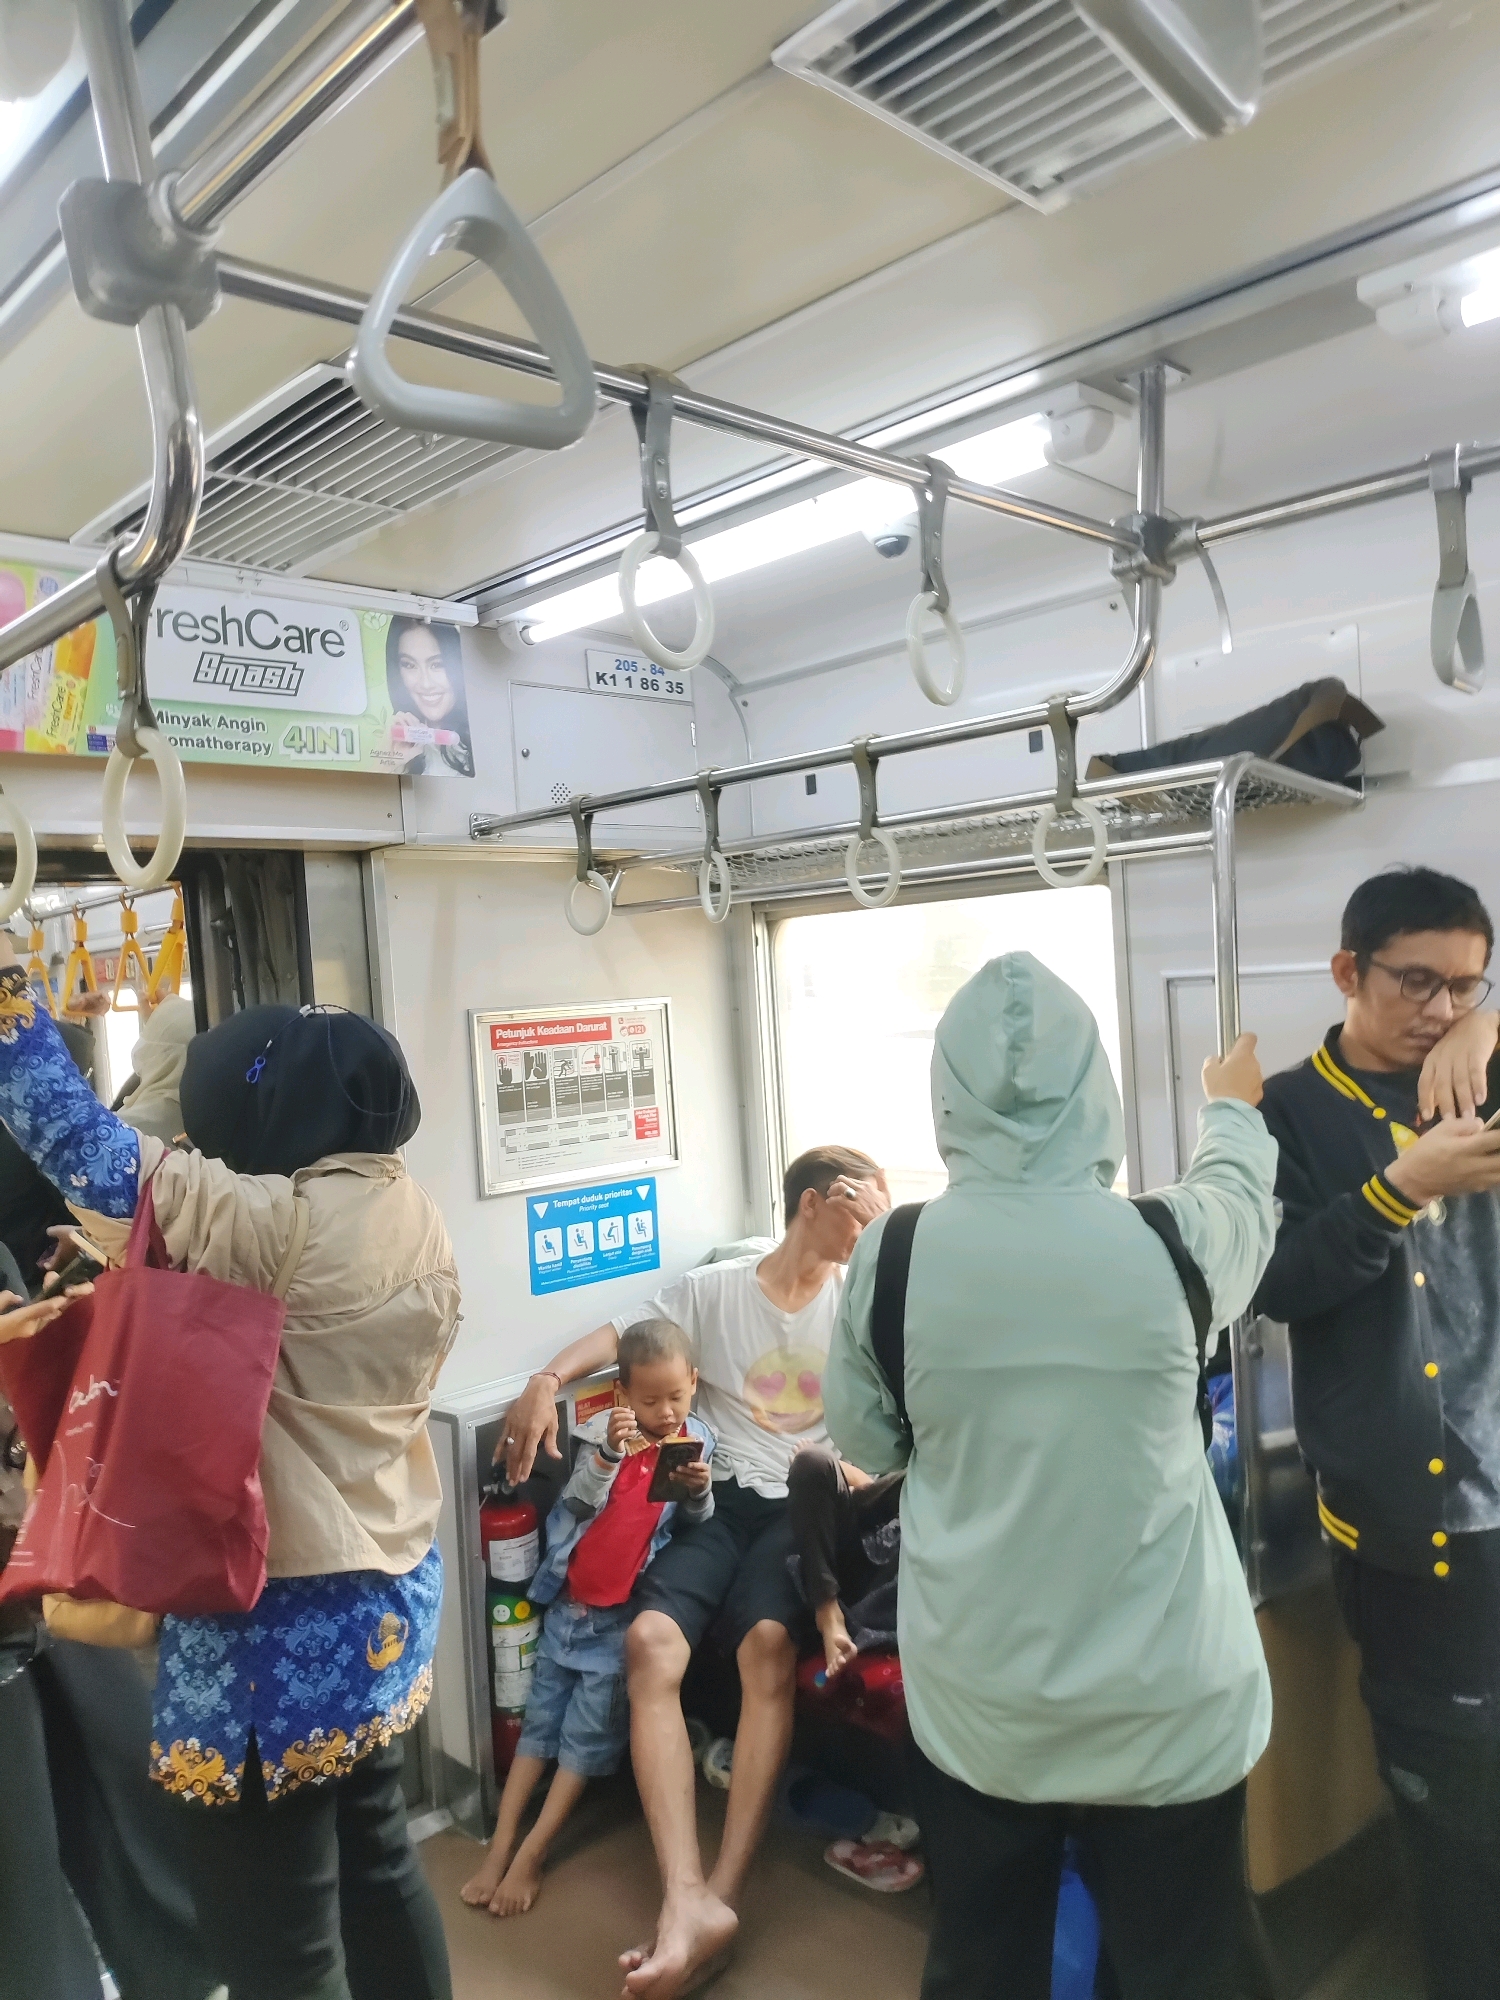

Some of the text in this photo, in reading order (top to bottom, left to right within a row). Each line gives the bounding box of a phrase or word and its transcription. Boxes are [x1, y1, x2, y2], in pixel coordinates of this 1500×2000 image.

[149, 605, 346, 658] reshCare
[193, 651, 304, 696] Smash
[614, 658, 638, 673] 205
[650, 663, 665, 676] 84
[595, 671, 684, 695] K1 1 86 35
[216, 715, 266, 733] Angin
[165, 735, 273, 756] omatherapy
[282, 725, 355, 755] 4IN1
[496, 1022, 607, 1040] Petunjuk Keadaan Darurat
[553, 1189, 632, 1209] Tempat duduk prioritas
[579, 1203, 597, 1212] Priority
